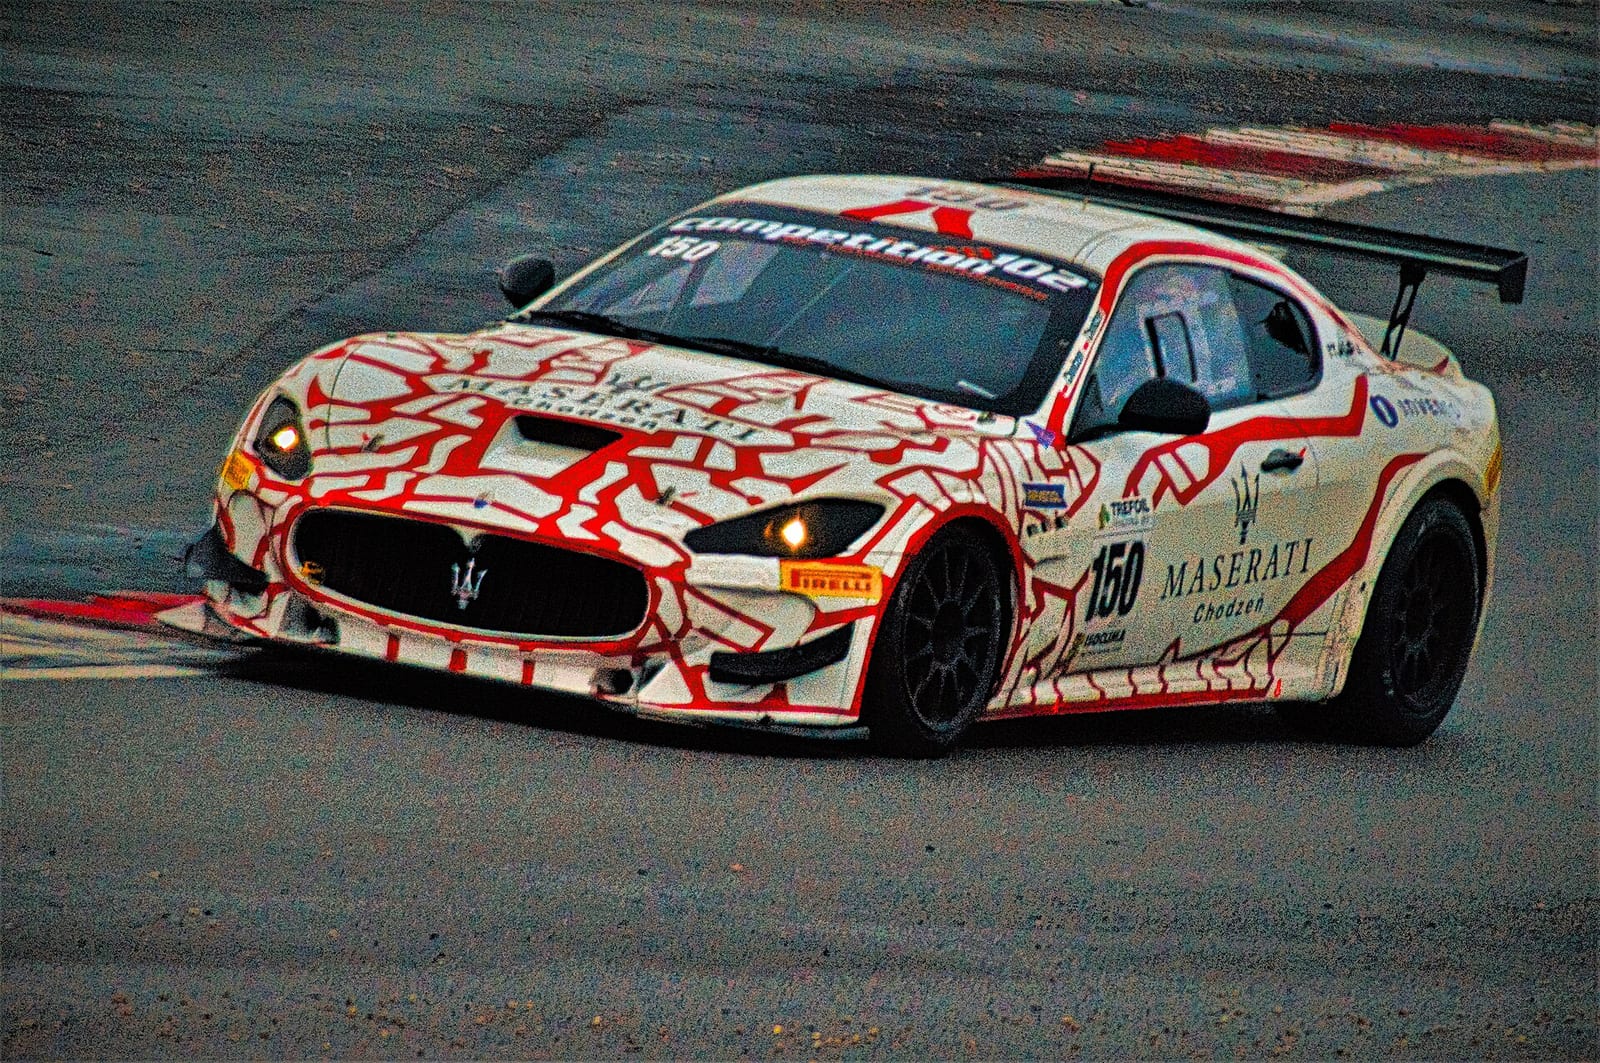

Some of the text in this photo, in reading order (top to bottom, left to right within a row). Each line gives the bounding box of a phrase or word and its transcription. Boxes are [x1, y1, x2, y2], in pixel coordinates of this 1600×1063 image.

[648, 235, 721, 262] 150
[445, 378, 758, 441] MASERATI
[791, 568, 872, 592] PIRELLI
[1084, 540, 1146, 622] 150
[1160, 537, 1313, 600] MASERATI
